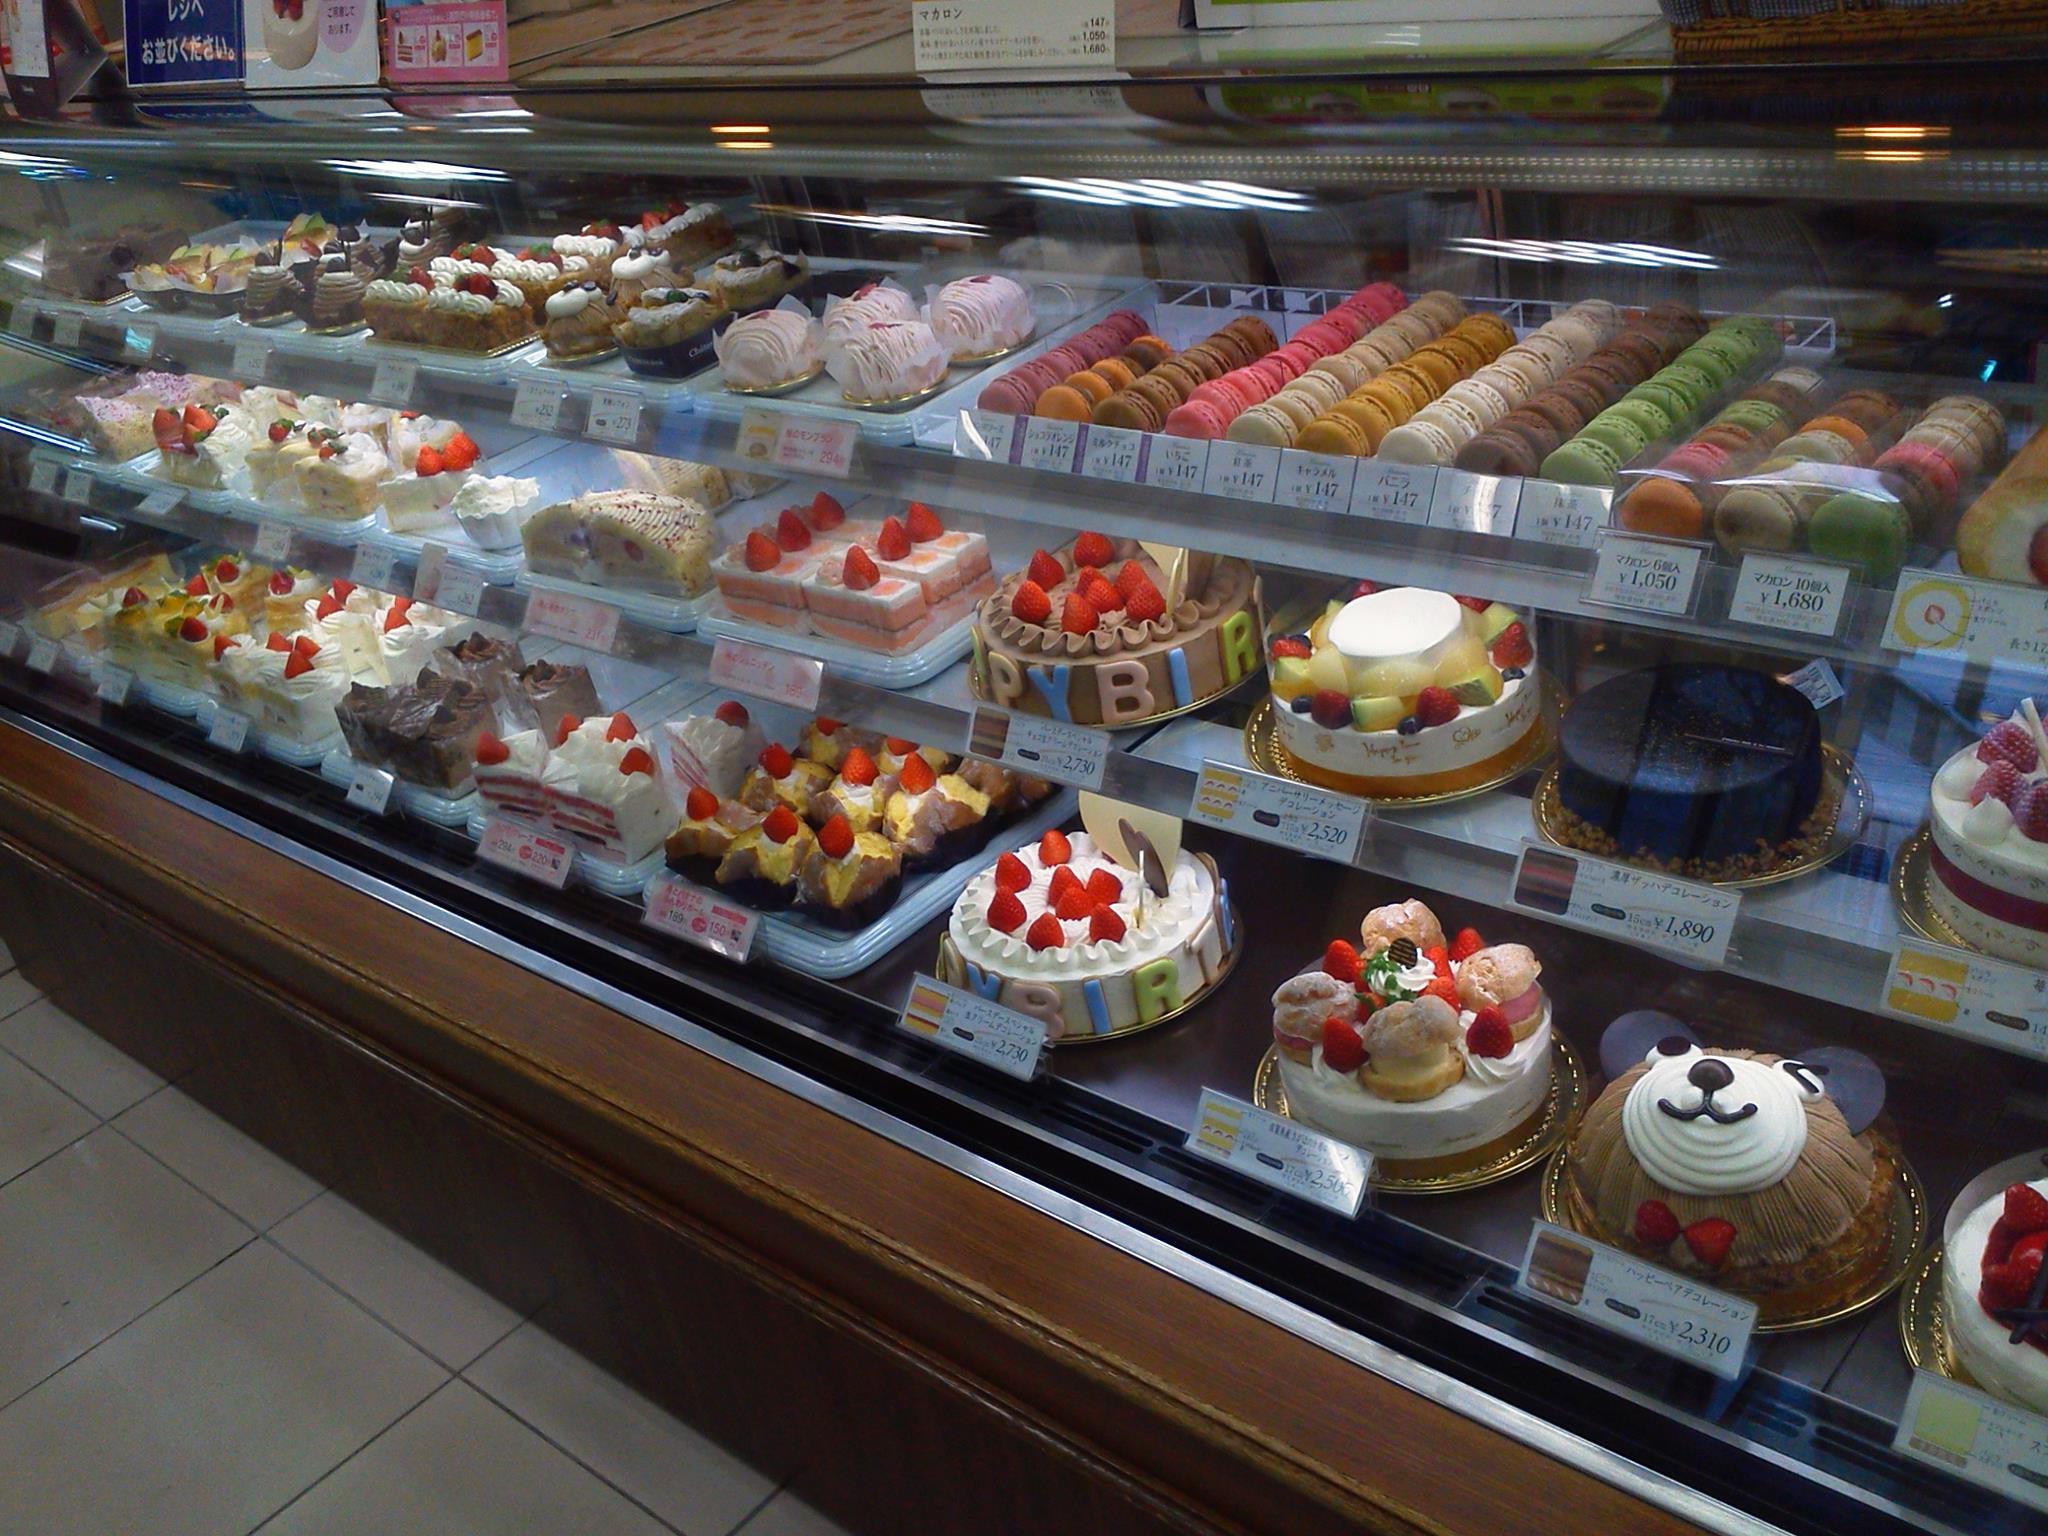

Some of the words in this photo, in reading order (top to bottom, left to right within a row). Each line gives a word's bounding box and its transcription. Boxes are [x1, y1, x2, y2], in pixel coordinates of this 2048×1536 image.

[920, 8, 962, 20] マカロン
[142, 34, 235, 64] お並びください。
[1378, 474, 1410, 489] バニラ
[1620, 570, 1677, 591] ¥1,050
[1761, 589, 1824, 612] ¥1,680
[1301, 822, 1349, 846] ¥2,520
[1654, 915, 1715, 944] ¥1,890
[1669, 1319, 1731, 1355] ¥2,310
